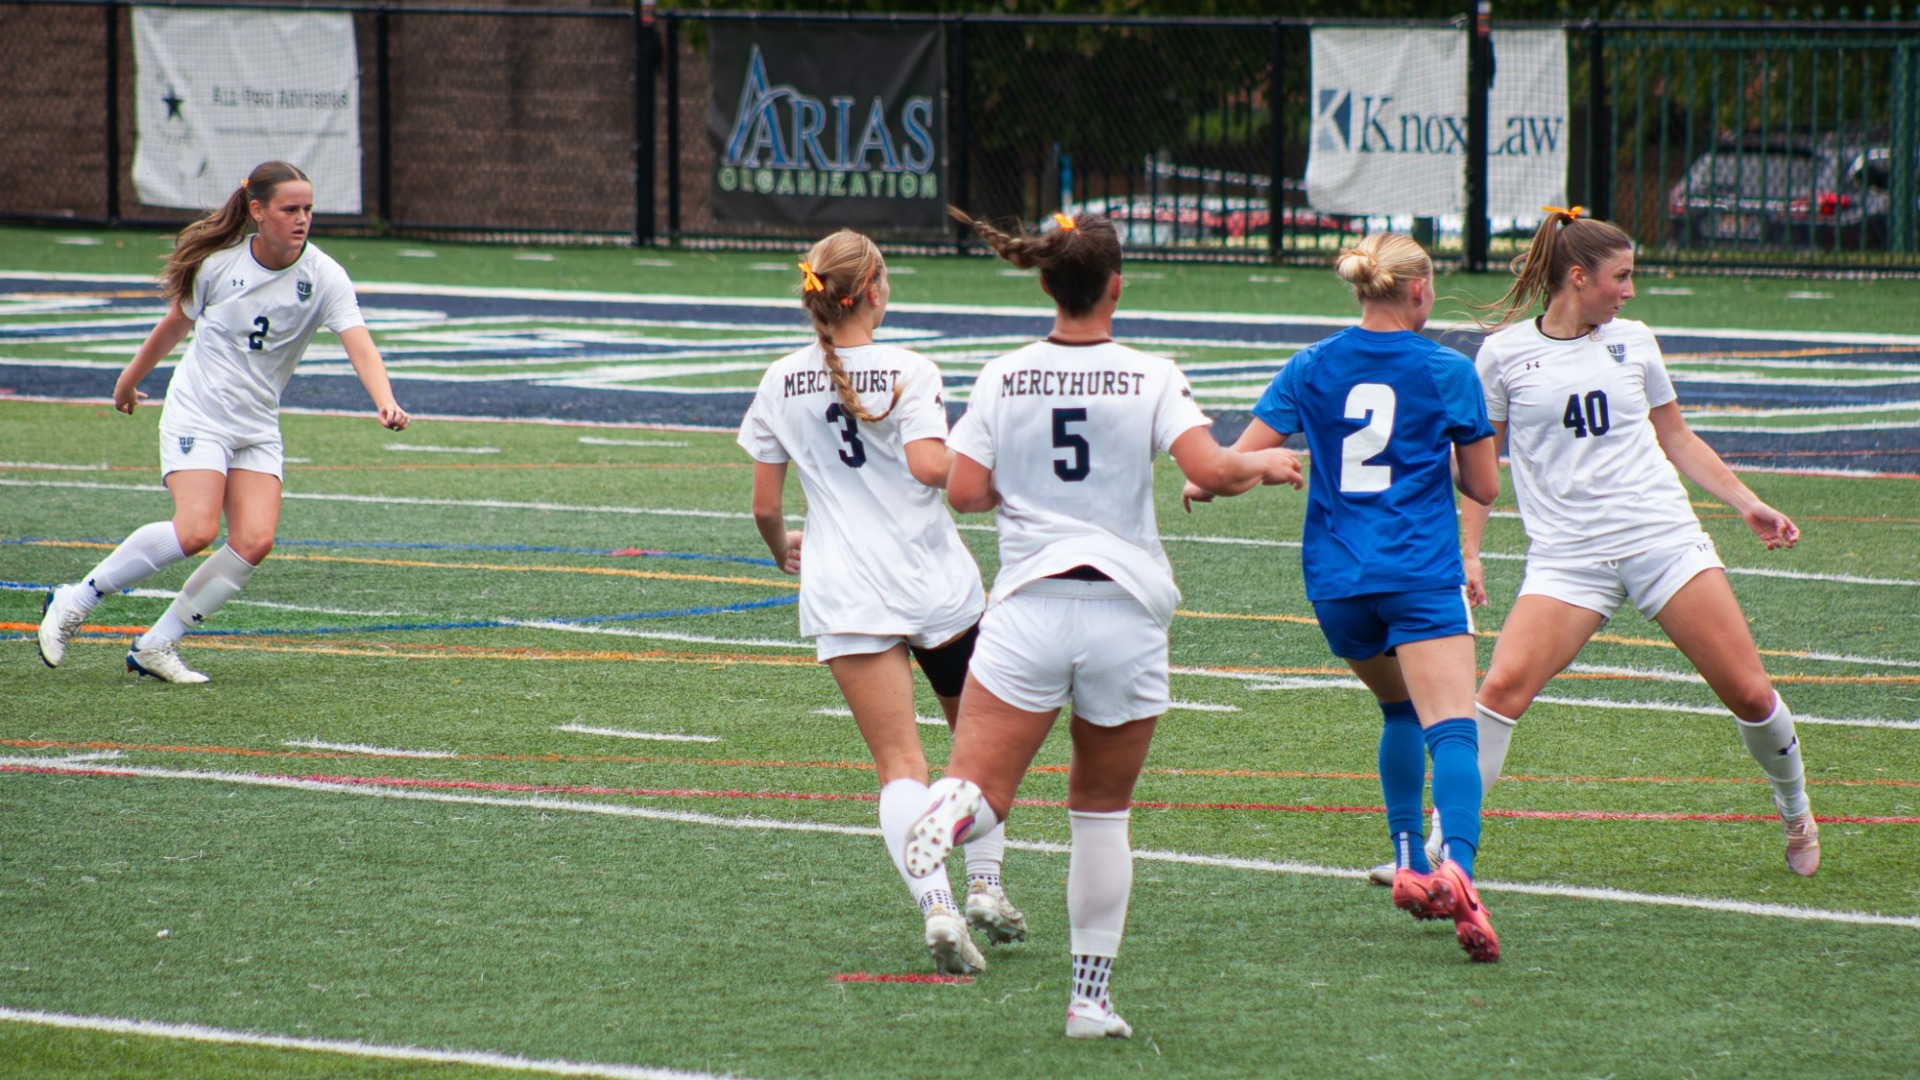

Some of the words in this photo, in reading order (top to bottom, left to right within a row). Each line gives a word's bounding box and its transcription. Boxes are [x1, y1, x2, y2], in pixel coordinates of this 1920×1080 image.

[722, 43, 935, 174] ARIAS
[249, 316, 269, 351] 2
[1001, 369, 1145, 397] MERCYHURST
[1562, 389, 1611, 439] 40
[825, 402, 867, 469] 3
[1052, 407, 1090, 482] 5
[1340, 383, 1396, 493] 2
